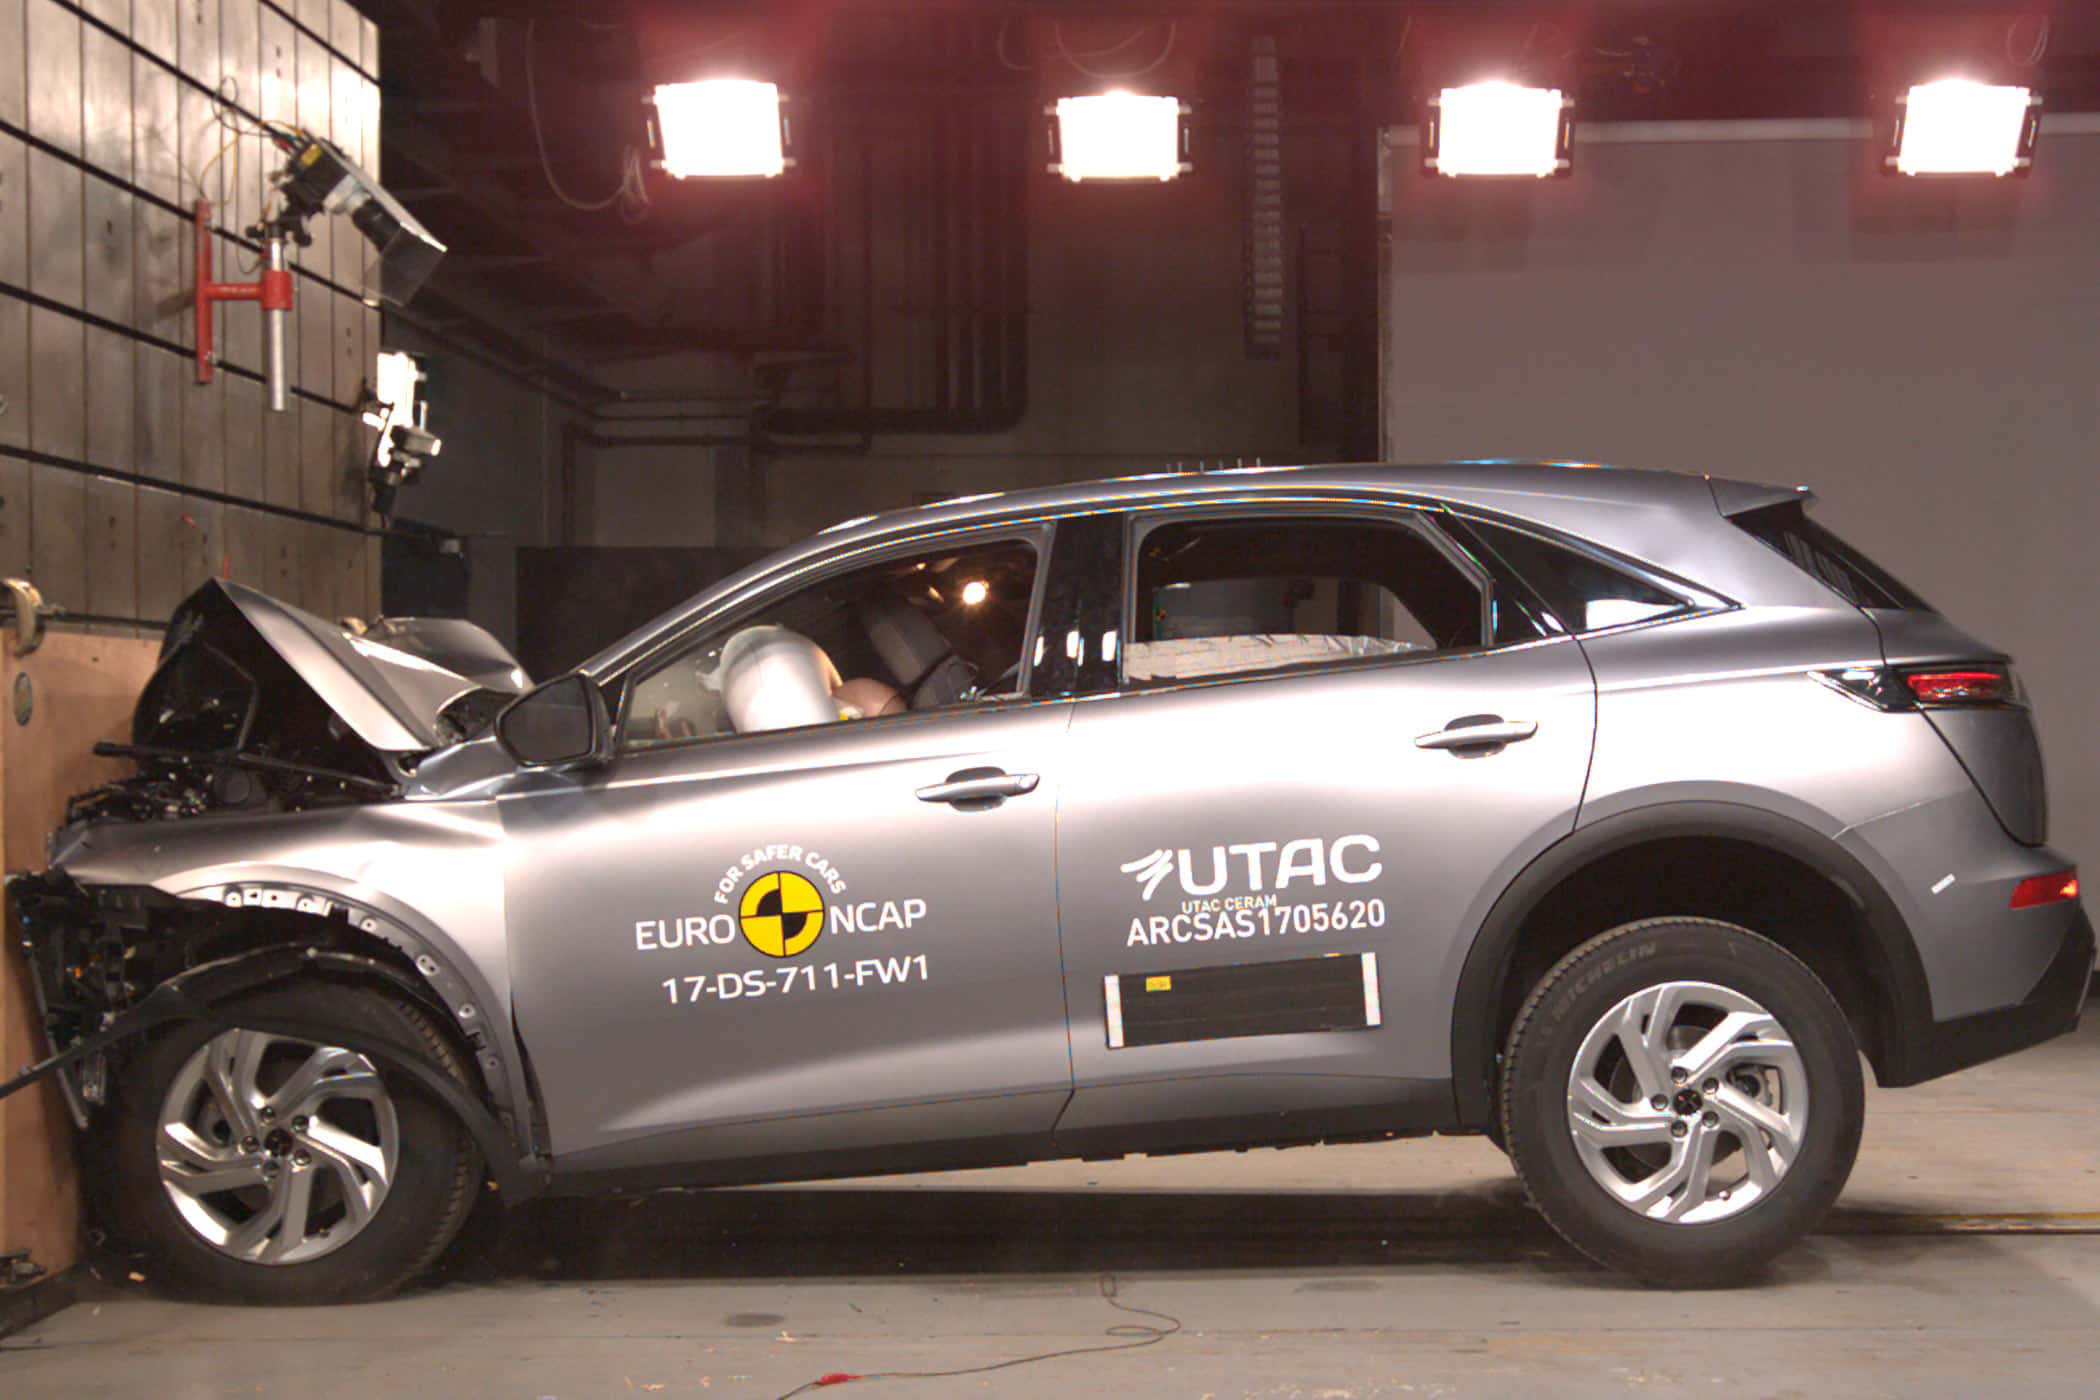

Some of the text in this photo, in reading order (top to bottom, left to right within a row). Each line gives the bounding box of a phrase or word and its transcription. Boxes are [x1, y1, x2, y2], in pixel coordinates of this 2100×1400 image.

[713, 844, 848, 905] FOR SAFER CARS
[1177, 834, 1383, 896] UTAC
[635, 898, 927, 950] EURO NCAP
[1126, 899, 1386, 947] ARCSAS1705620
[1181, 894, 1278, 914] UTAC CERAM
[661, 954, 929, 1004] 17-DS-711-FW1
[1553, 941, 1657, 1022] MICHELIN
